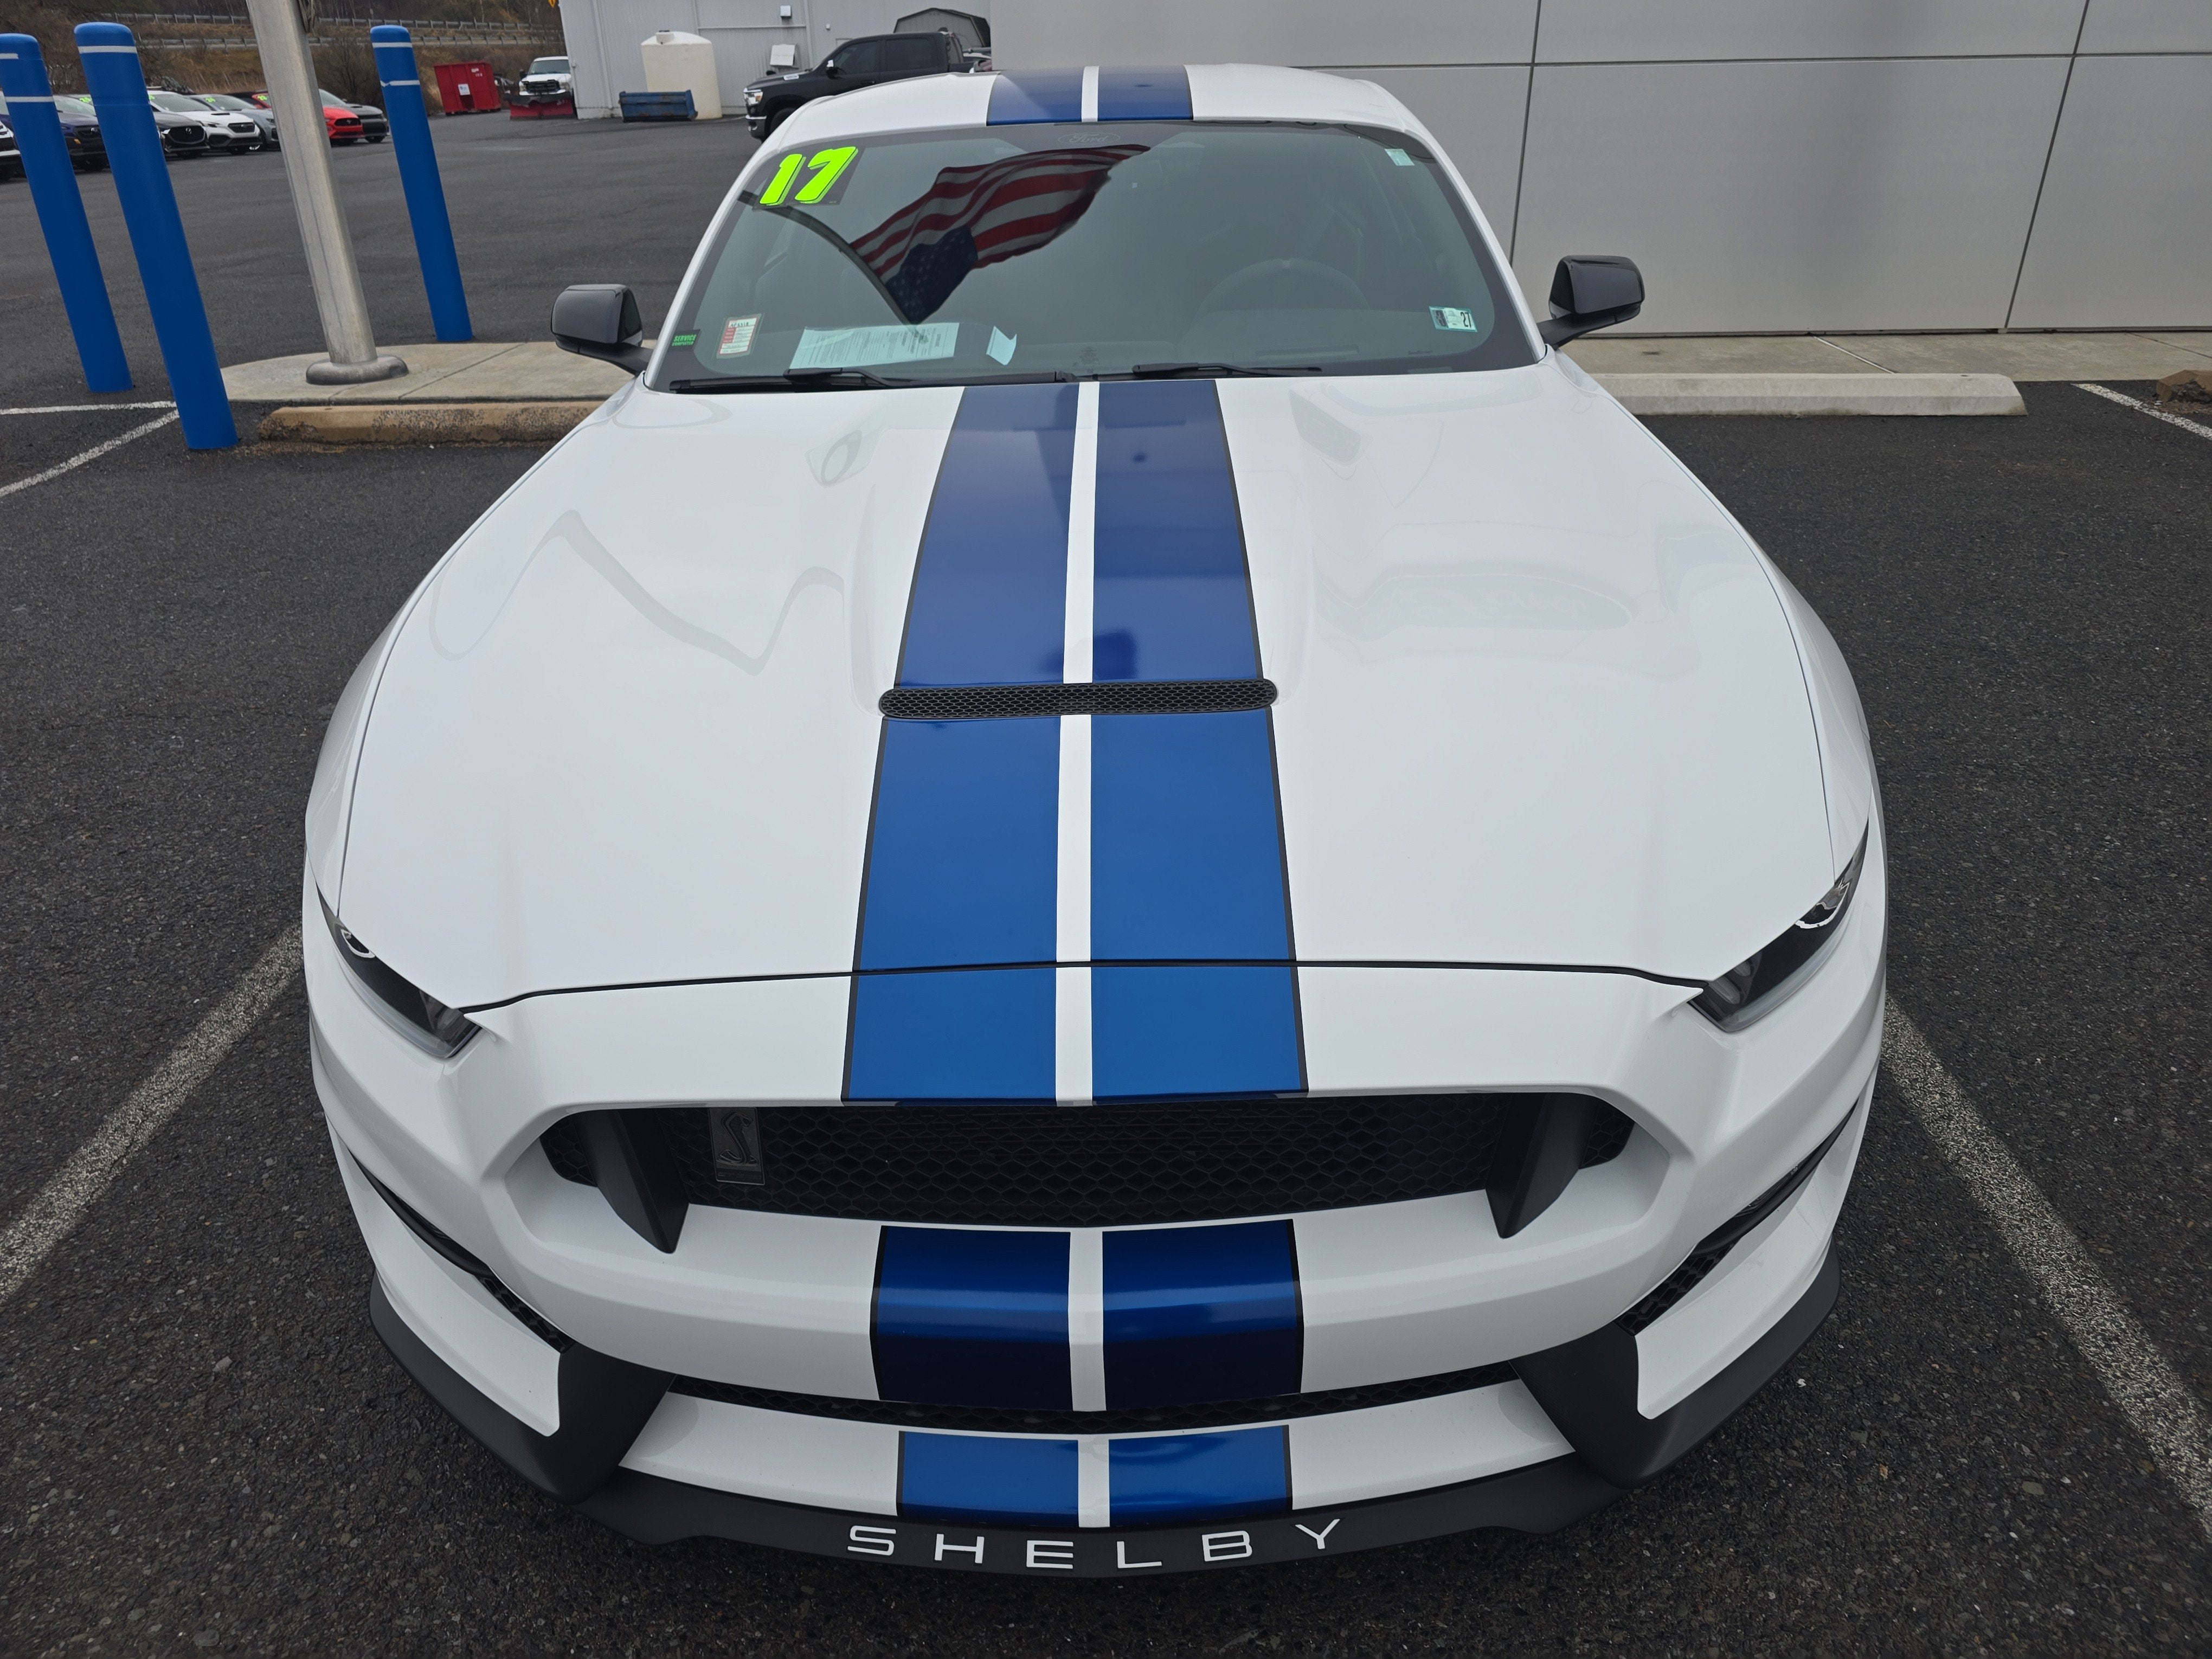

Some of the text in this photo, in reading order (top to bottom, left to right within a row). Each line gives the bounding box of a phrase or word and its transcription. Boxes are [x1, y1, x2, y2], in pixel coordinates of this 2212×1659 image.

[1069, 133, 1109, 142] Ford
[760, 146, 859, 205] 17
[1460, 312, 1471, 327] 27
[847, 1518, 1341, 1569] SHELBY
